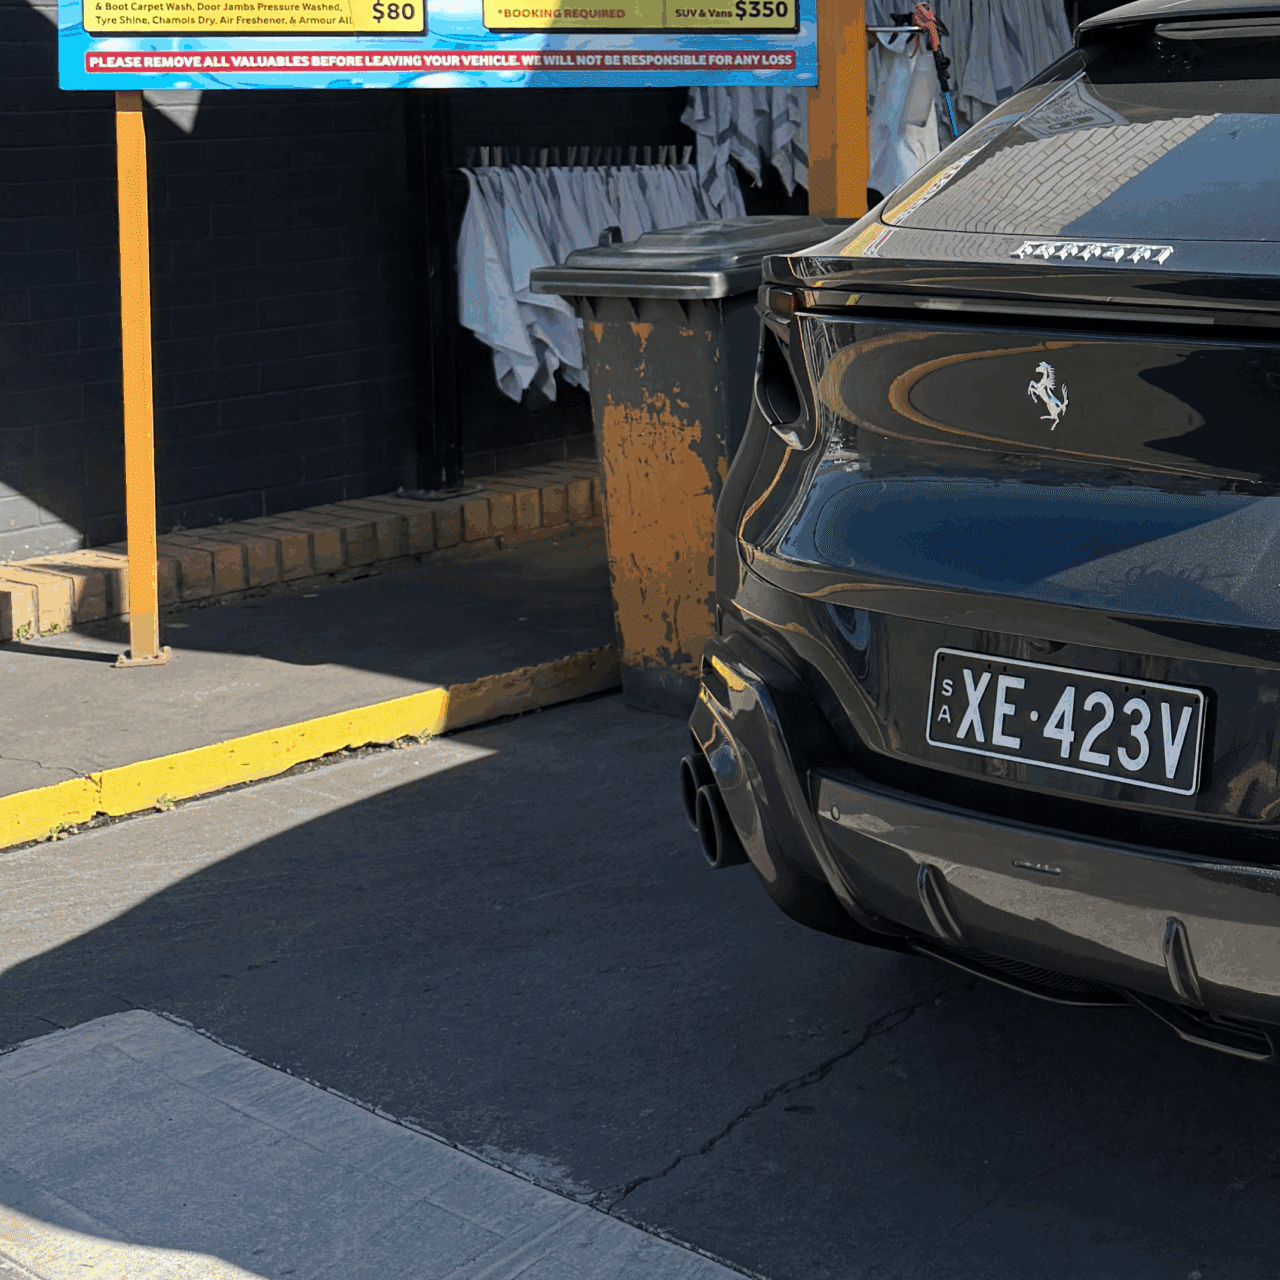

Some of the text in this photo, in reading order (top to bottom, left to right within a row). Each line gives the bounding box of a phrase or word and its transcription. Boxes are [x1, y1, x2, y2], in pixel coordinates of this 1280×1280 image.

[373, 0, 415, 23] $80
[564, 9, 625, 19] REQUIRED
[675, 9, 697, 17] SUV
[698, 9, 706, 17] &
[708, 9, 733, 17] Vans
[90, 55, 792, 67] PLEASE REMOVE ALL VALUABLES BEFORE LEAVING YOUR VEHICLE. WE WILL NOT BE RESPONSIBLE FOR ANY LOSS
